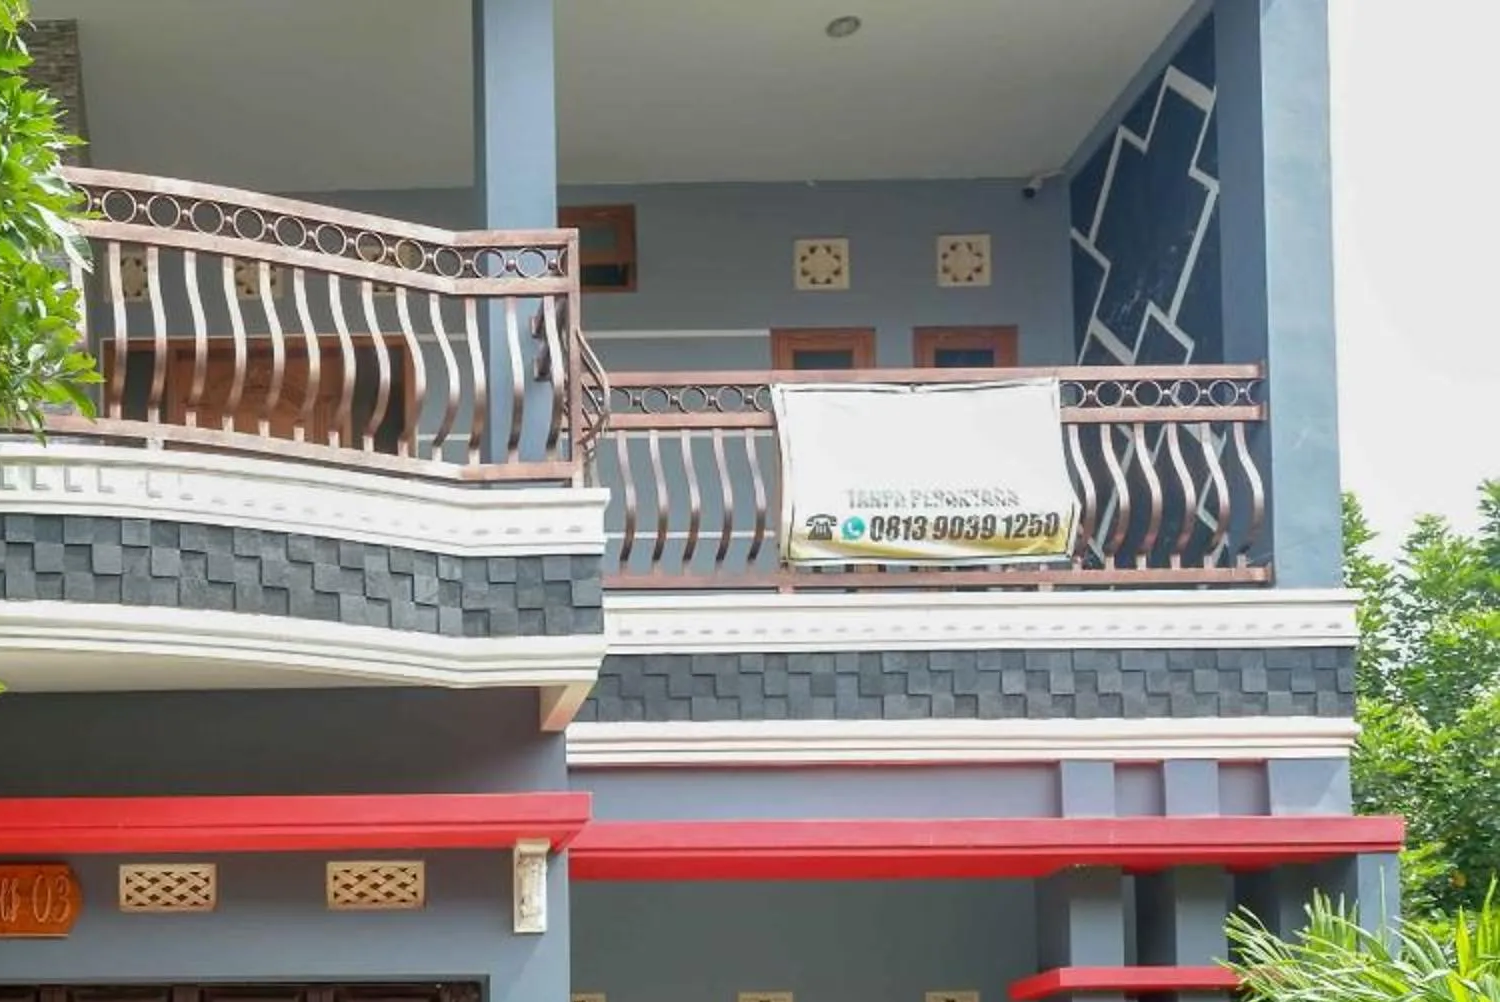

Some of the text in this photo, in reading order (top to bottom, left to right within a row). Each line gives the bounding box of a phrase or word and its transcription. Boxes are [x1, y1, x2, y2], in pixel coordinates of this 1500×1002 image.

[869, 511, 1061, 542] 0813 9039 1250
